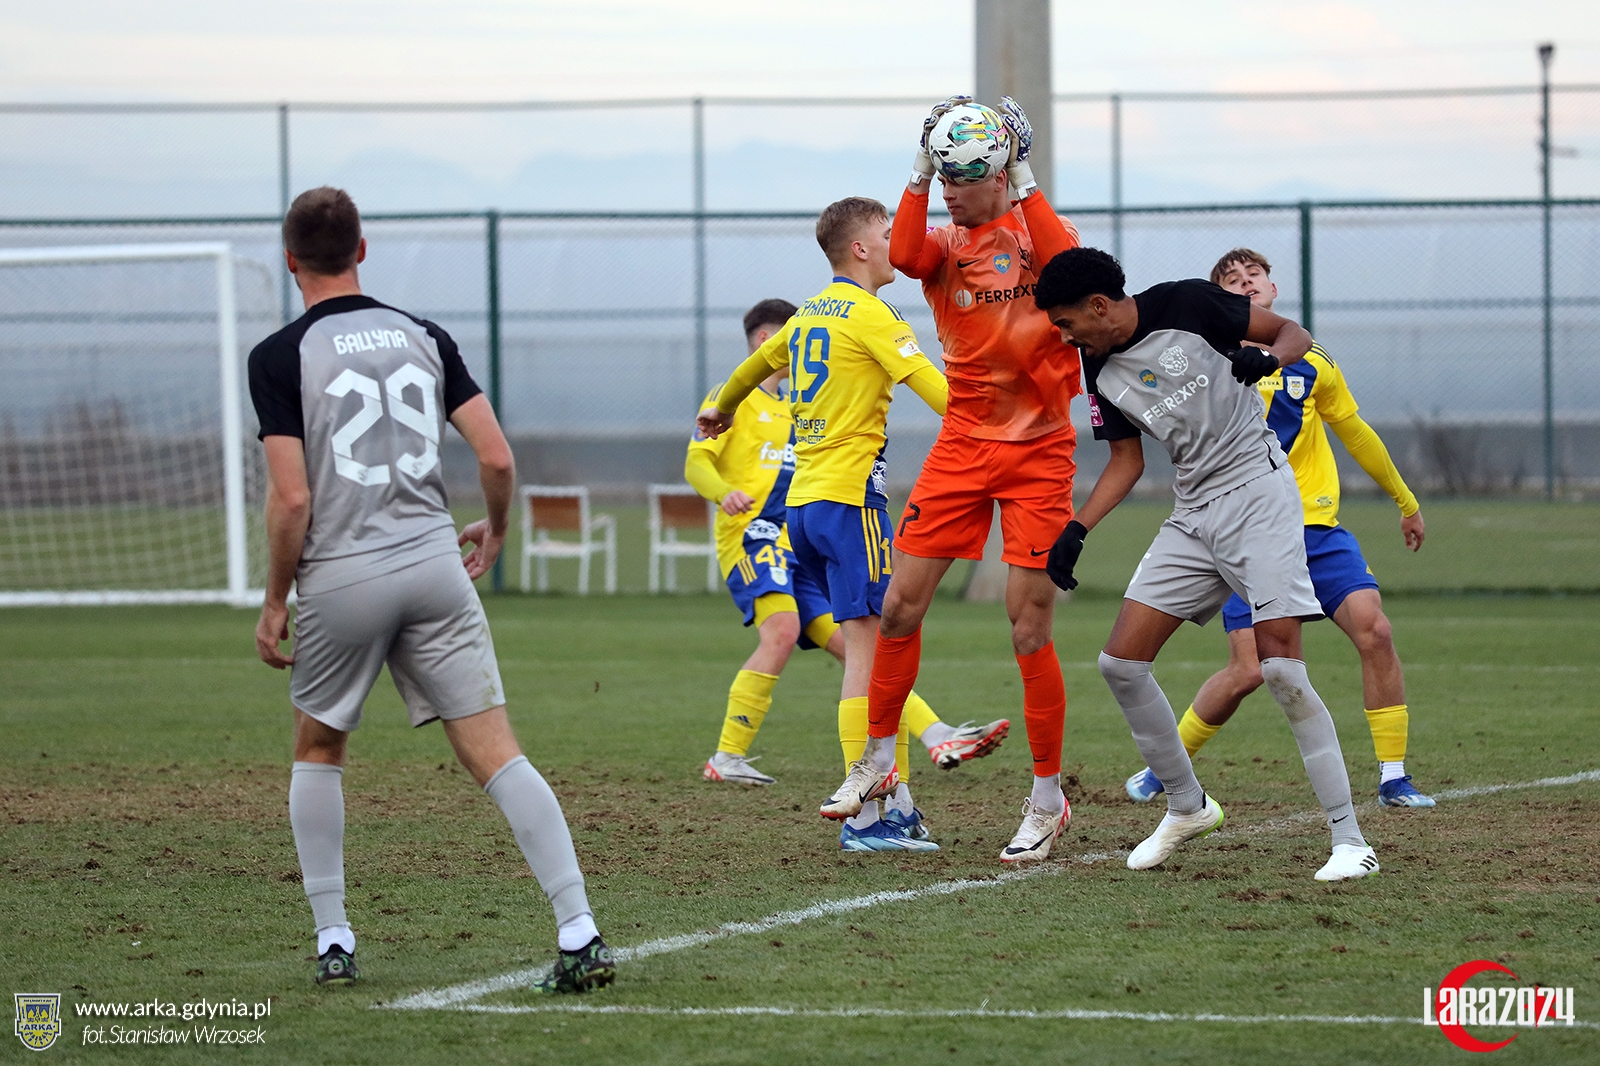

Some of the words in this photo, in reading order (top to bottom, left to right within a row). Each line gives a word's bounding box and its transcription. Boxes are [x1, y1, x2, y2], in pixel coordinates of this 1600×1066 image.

[975, 284, 1038, 304] FERREXP
[789, 327, 831, 403] 19
[324, 362, 440, 487] 29
[1142, 374, 1209, 425] FERREXPO
[760, 441, 797, 464] forB
